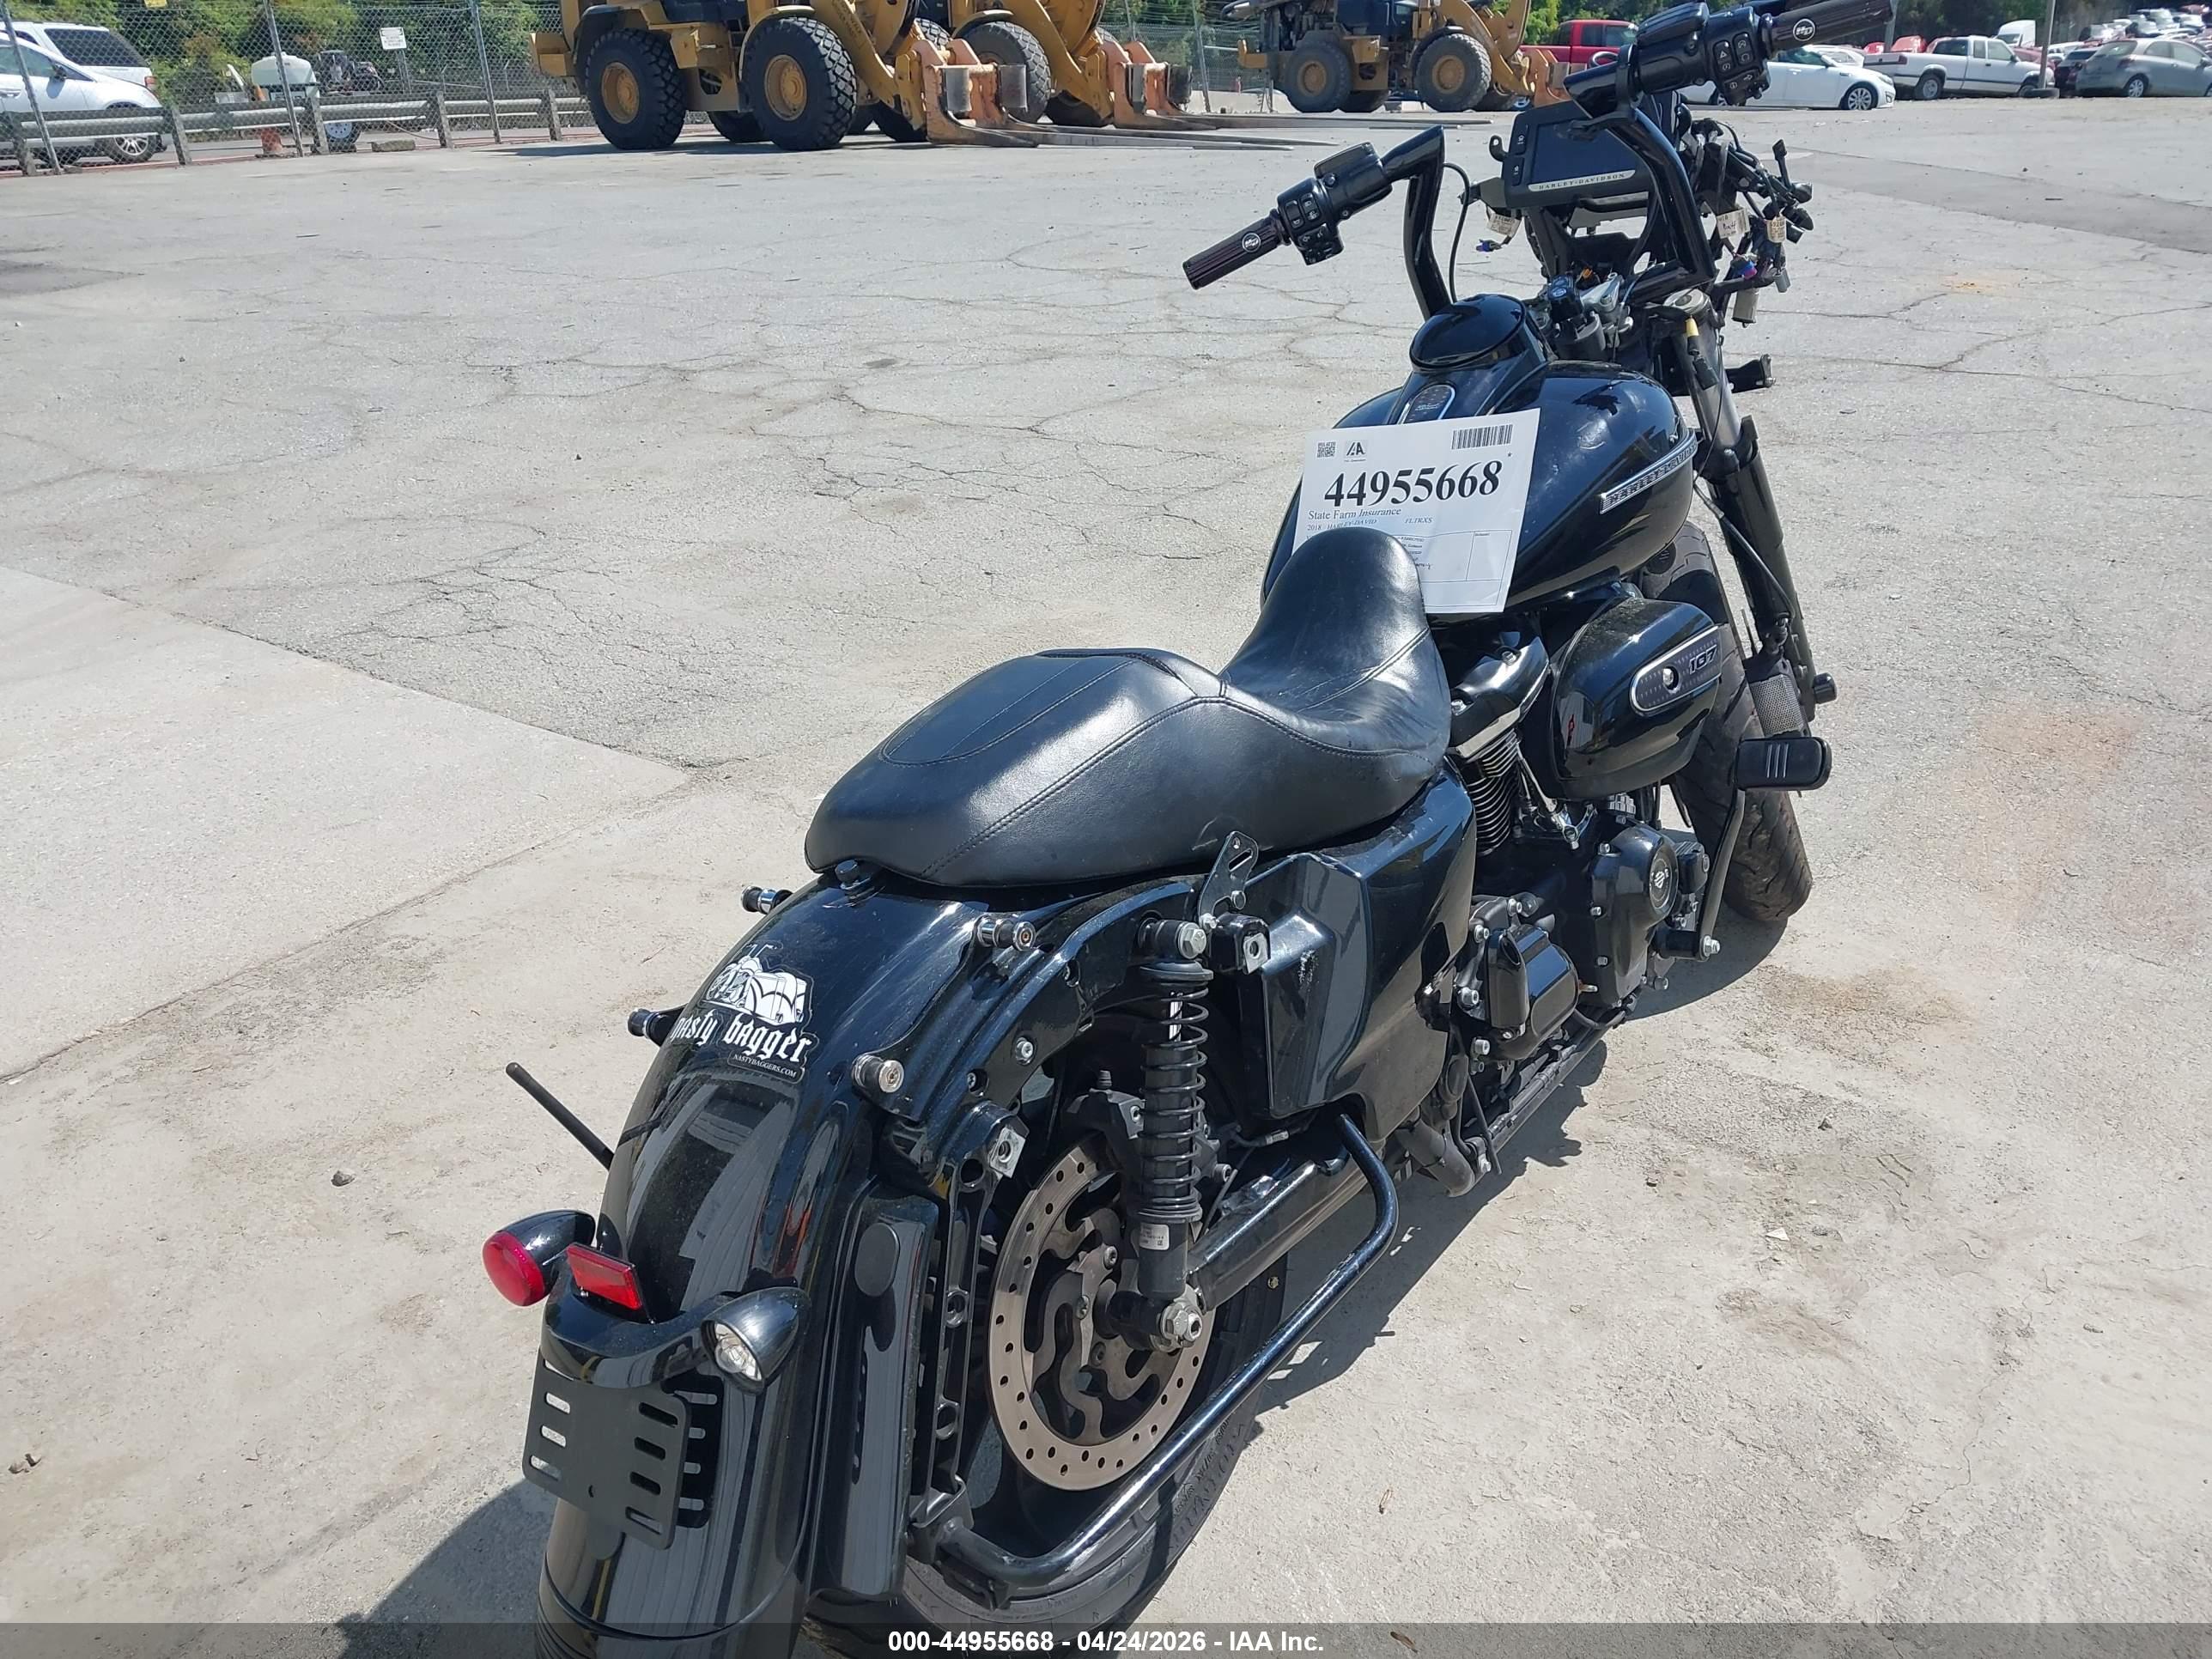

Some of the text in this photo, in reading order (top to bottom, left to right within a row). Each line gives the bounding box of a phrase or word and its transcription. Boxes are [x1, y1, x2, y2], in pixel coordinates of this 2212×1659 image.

[1539, 173, 1626, 190] HARLEY-DAVIDSON
[1324, 460, 1503, 507] 44955668
[1308, 507, 1402, 520] State Farm Insurance
[1689, 645, 1717, 674] 107
[670, 1009, 812, 1062] nasty bagger
[732, 1054, 797, 1079] NASTYBAGGERS.COM
